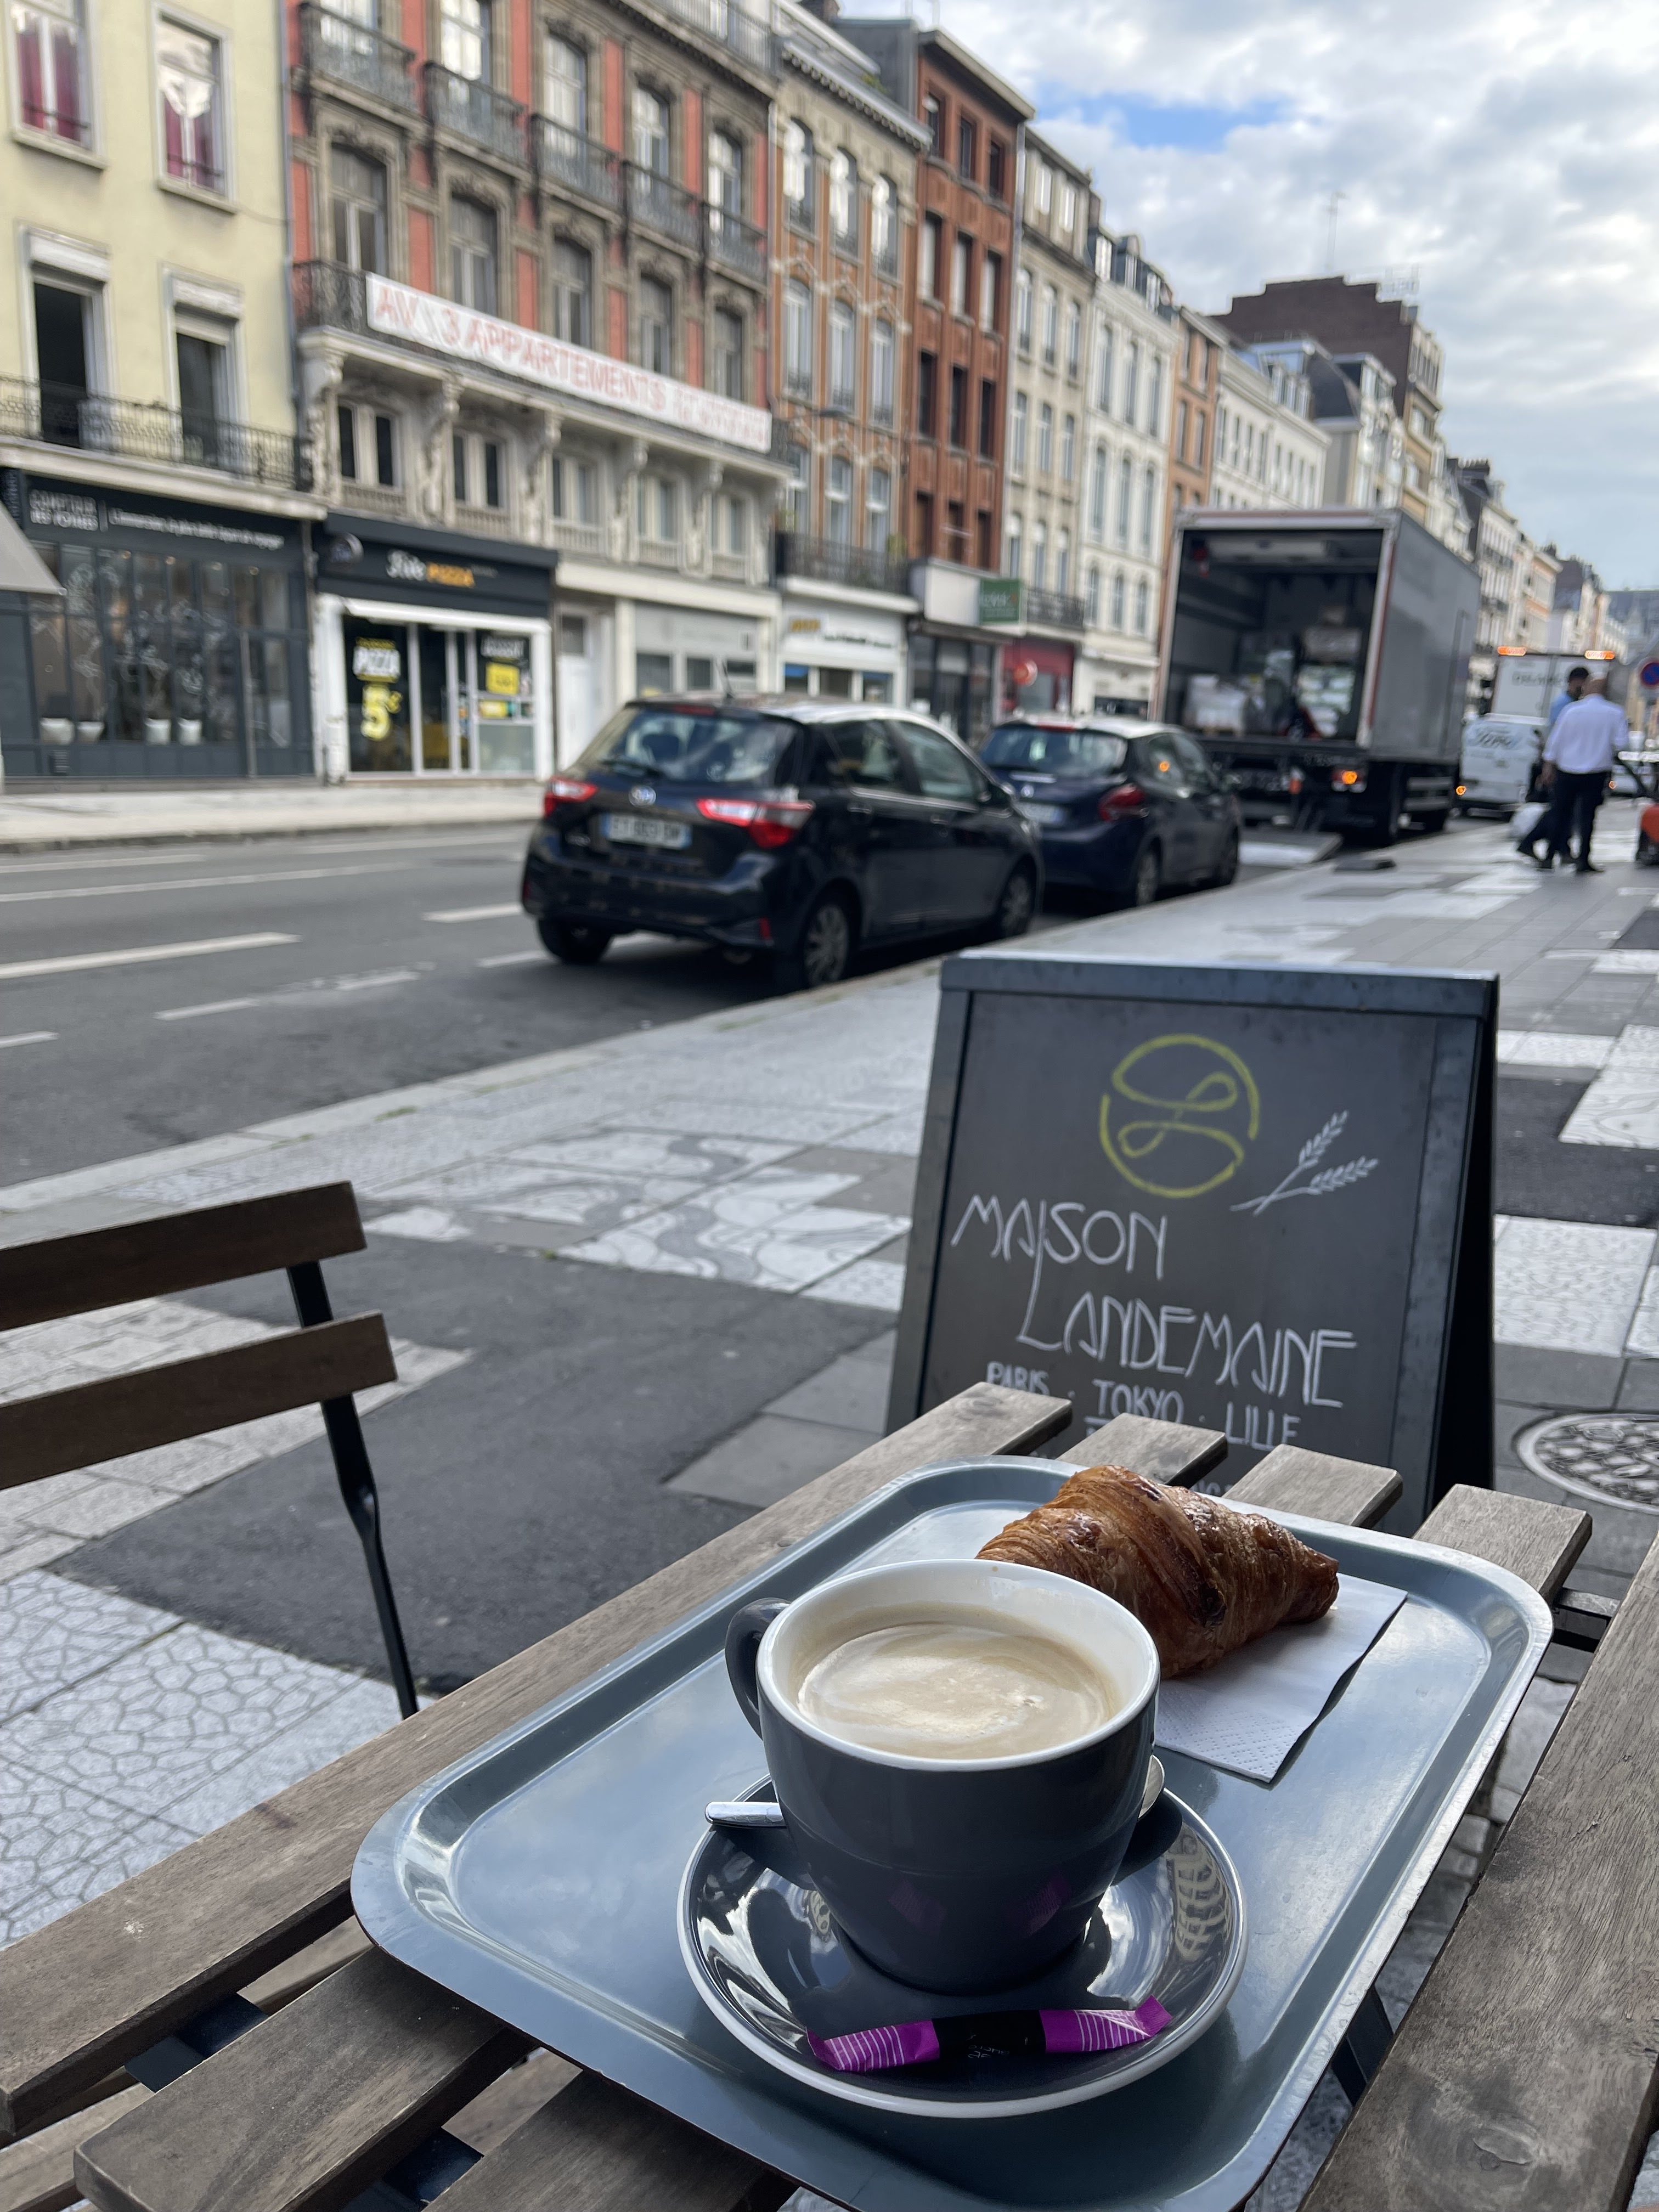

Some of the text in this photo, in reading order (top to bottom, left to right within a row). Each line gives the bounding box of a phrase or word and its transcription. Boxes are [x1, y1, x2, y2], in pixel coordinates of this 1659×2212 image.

[465, 317, 668, 412] APPARTEMENTS
[951, 1193, 1167, 1281] MAISON
[1016, 1289, 1358, 1409] LANDEMAINE
[986, 1361, 1301, 1451] PARIS TOKYO LILLE
